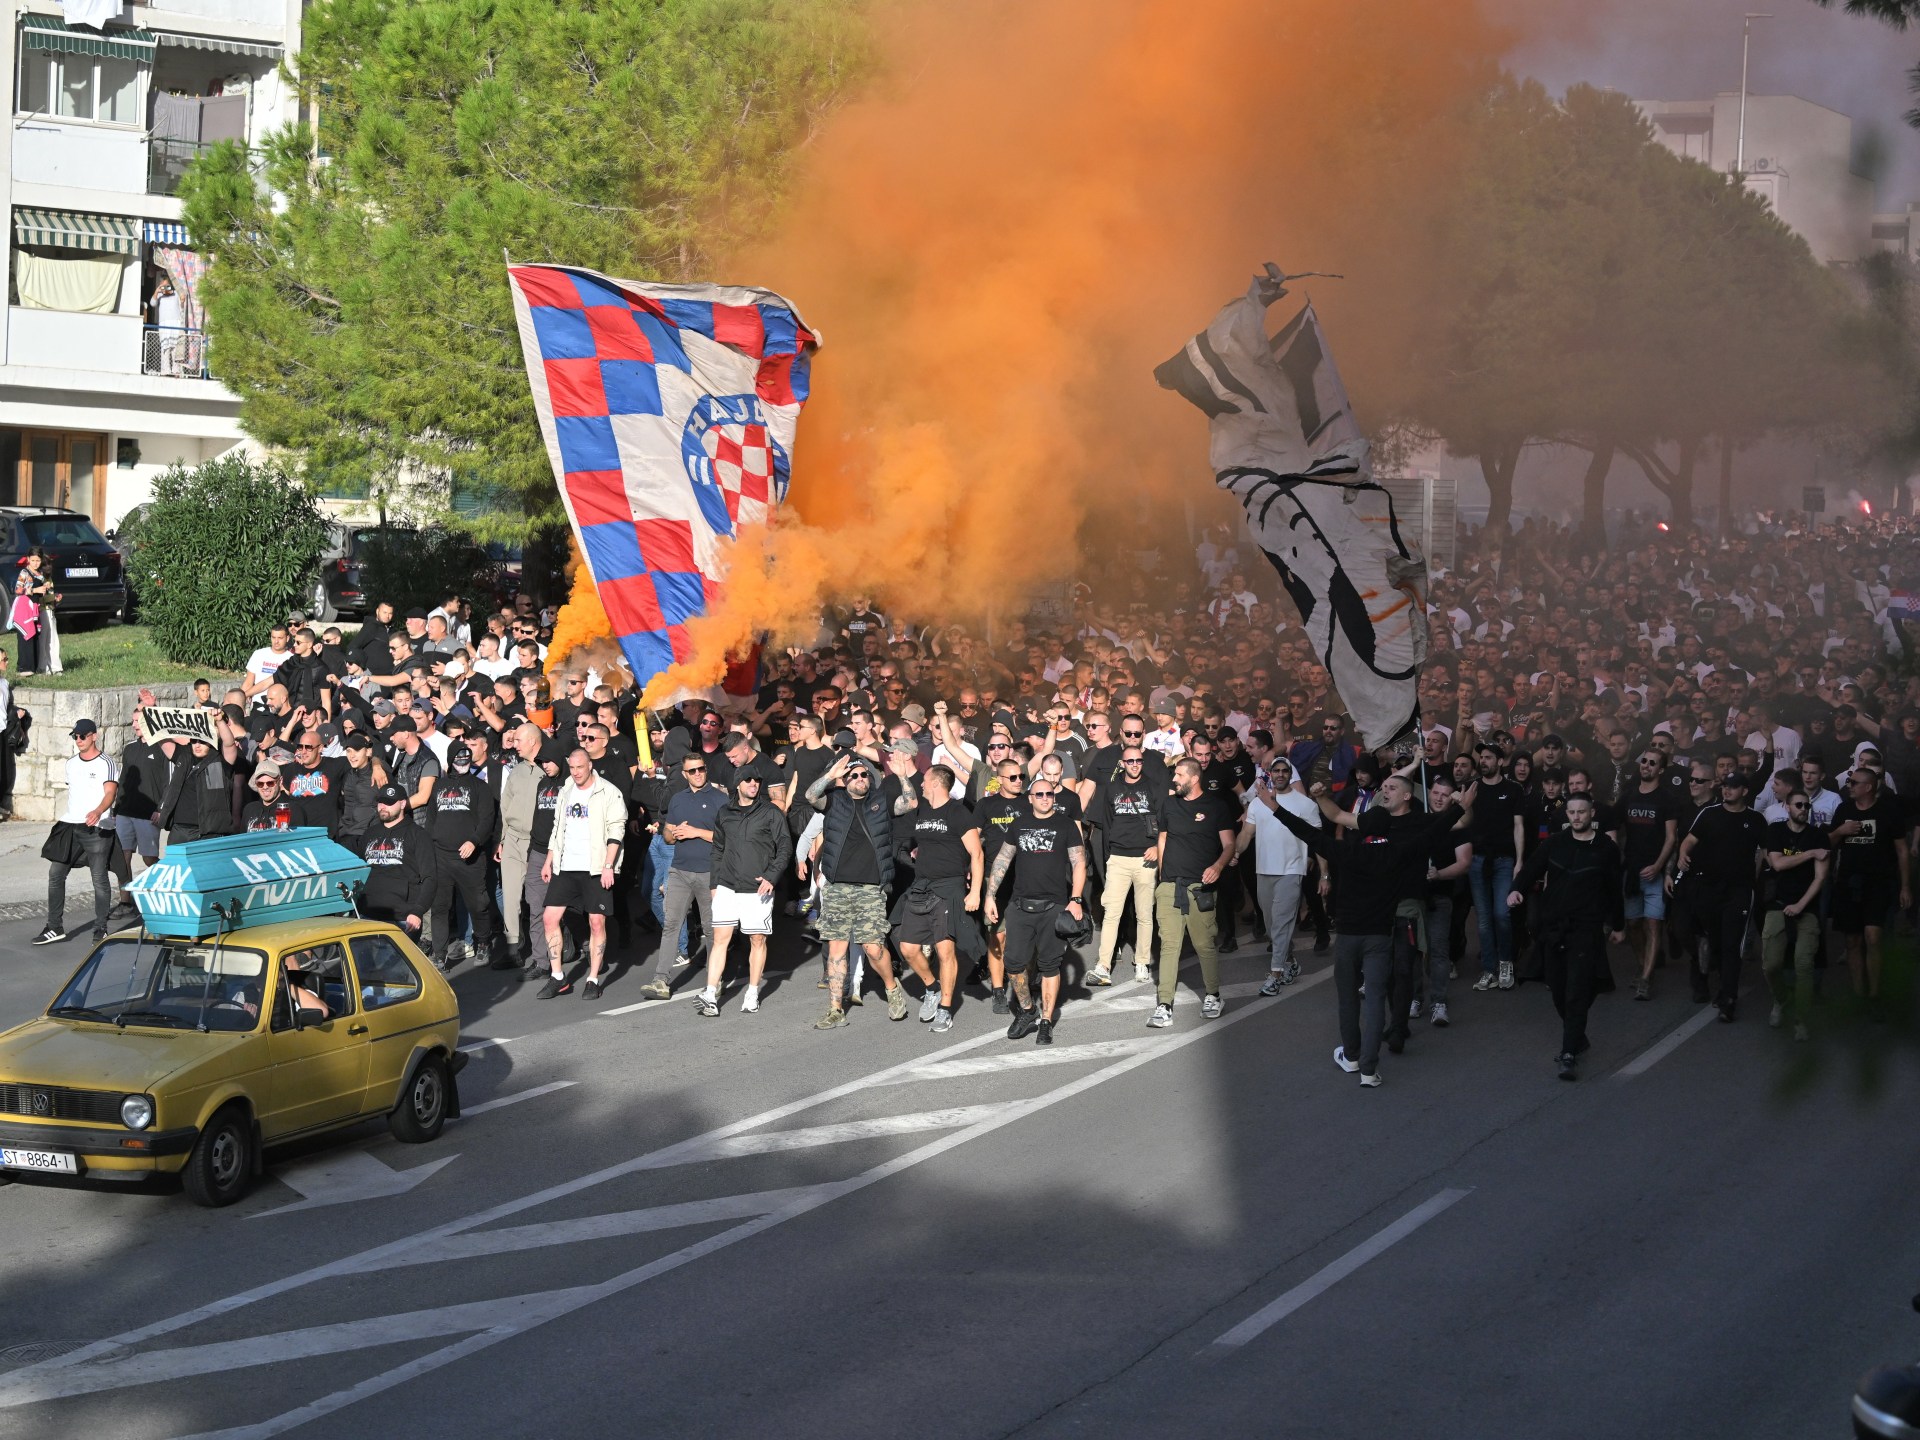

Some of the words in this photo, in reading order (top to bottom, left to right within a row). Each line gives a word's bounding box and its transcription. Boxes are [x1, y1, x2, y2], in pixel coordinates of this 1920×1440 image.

[142, 707, 214, 740] KLOŠARI
[4, 1150, 18, 1164] ST
[27, 1152, 69, 1169] 8864-I
